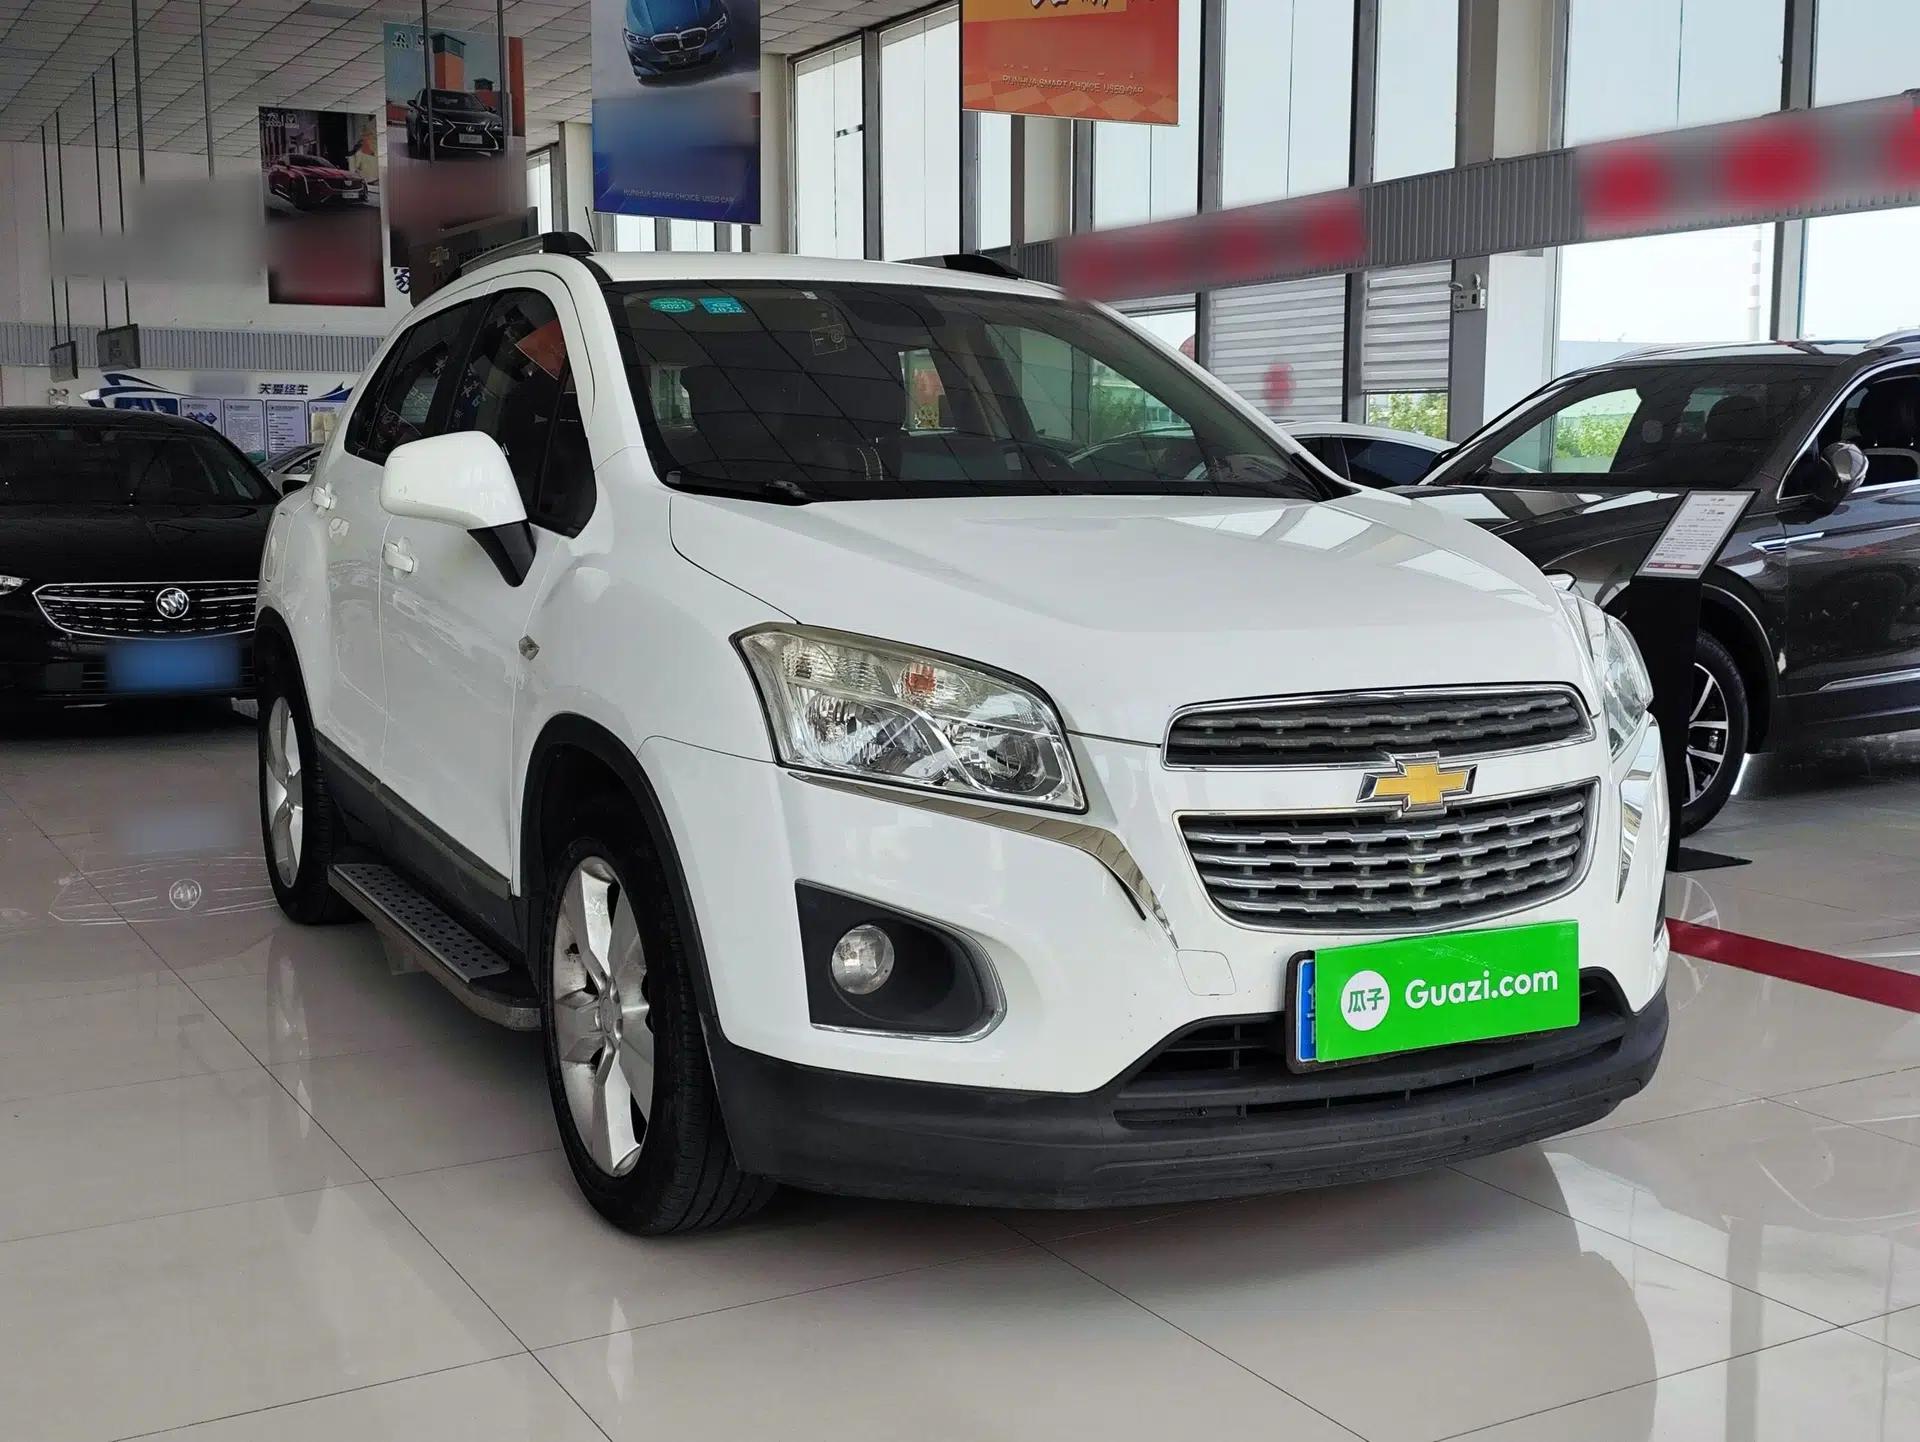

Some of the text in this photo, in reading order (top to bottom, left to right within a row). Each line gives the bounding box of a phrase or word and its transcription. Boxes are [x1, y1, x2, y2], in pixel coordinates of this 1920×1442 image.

[1039, 79, 1067, 89] SMART
[1348, 987, 1385, 1014] 瓜子
[1405, 970, 1558, 1009] Guazi.com
